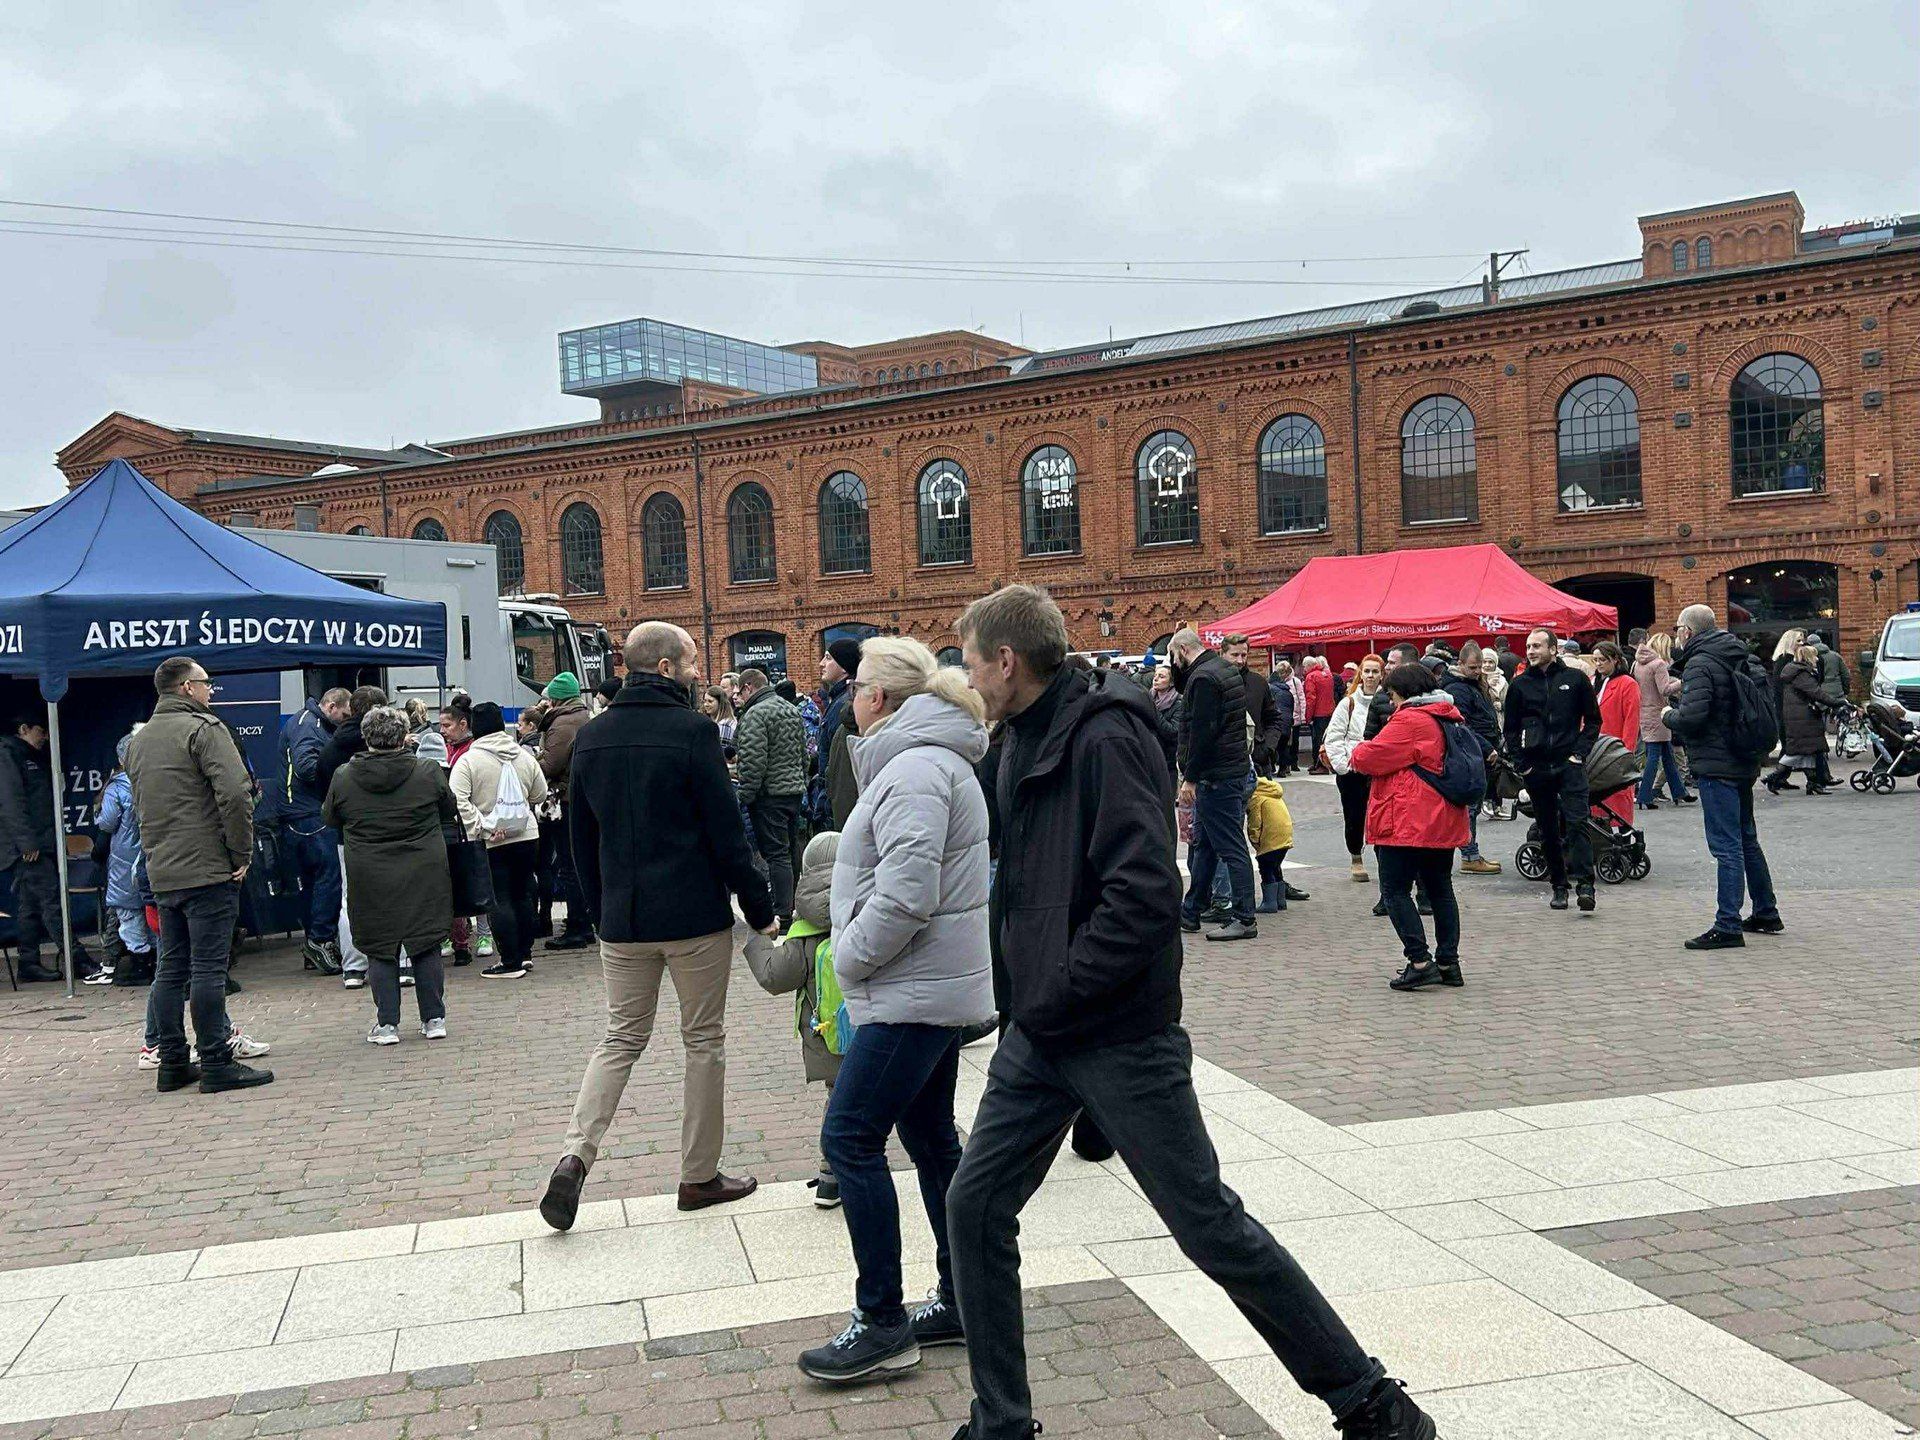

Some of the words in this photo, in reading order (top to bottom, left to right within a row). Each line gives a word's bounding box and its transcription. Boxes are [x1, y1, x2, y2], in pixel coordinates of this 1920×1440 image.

[1873, 214, 1903, 229] BAR
[1038, 457, 1071, 478] PAN
[83, 619, 190, 650] ARESZT
[199, 610, 315, 646] ŚLEDCZY
[322, 620, 347, 646] W
[353, 621, 423, 649] ŁODZI
[1317, 626, 1369, 638] Administracji
[1371, 624, 1415, 635] Skarbowej
[1416, 625, 1424, 633] w
